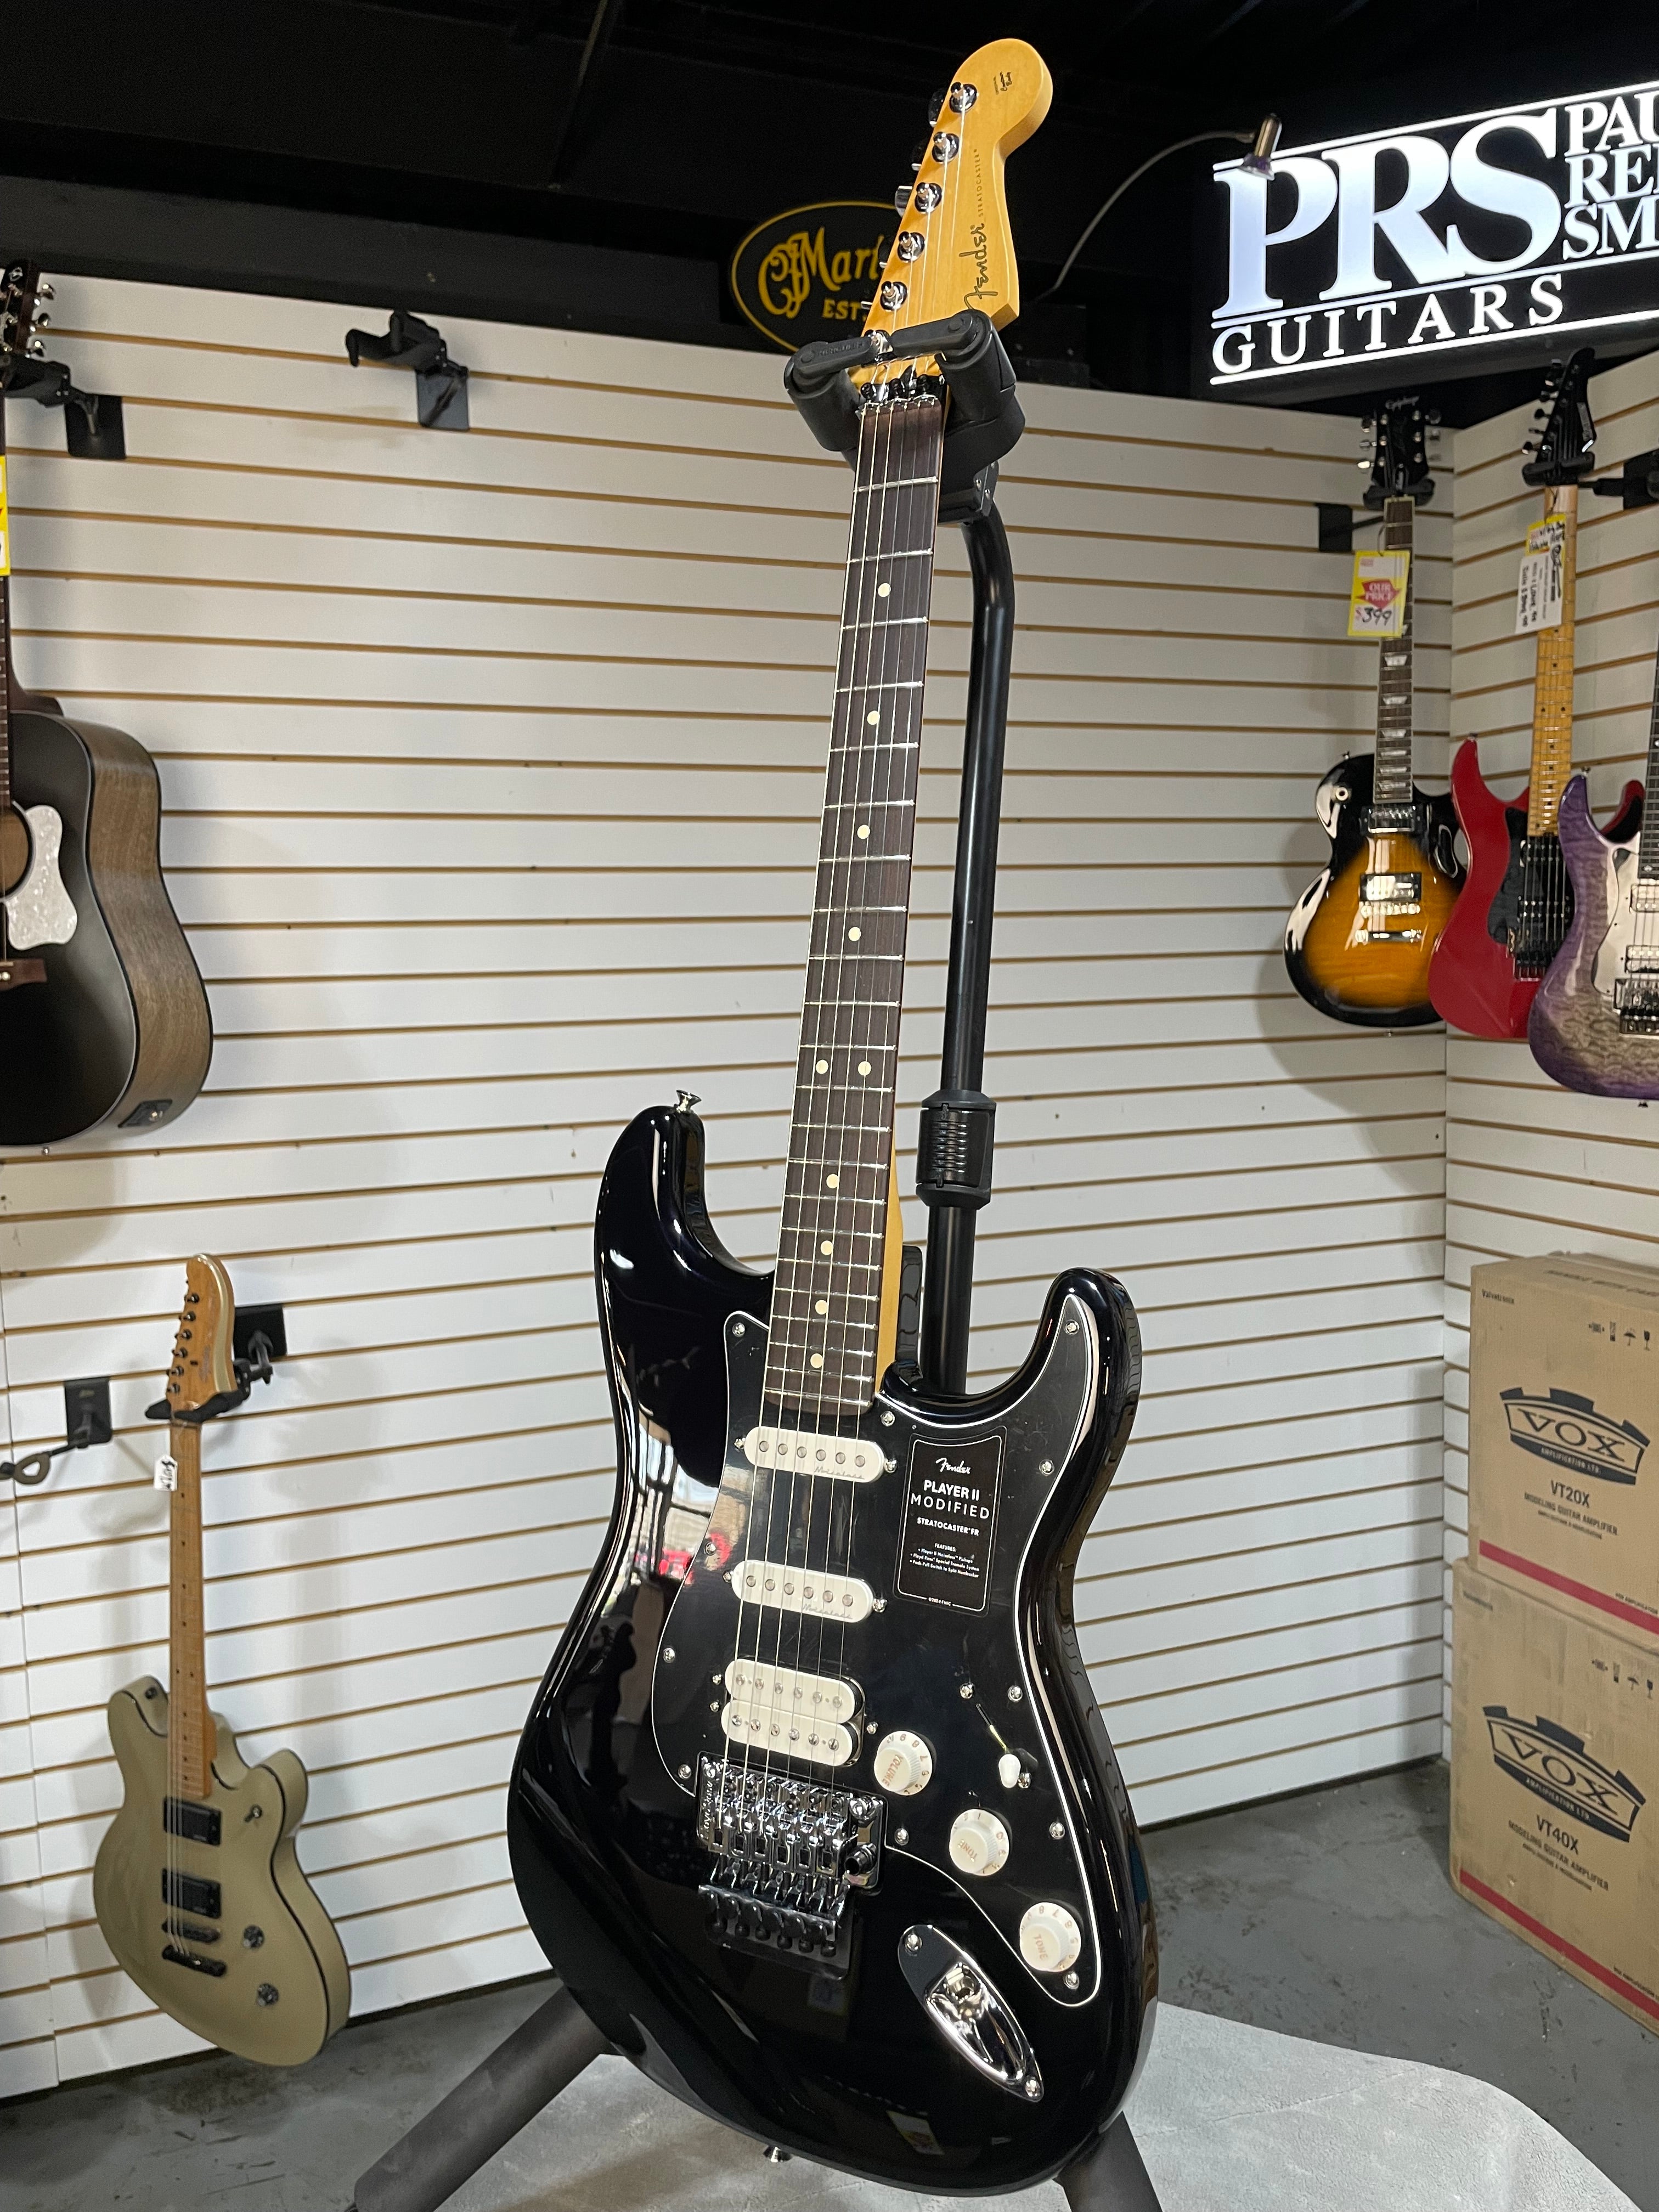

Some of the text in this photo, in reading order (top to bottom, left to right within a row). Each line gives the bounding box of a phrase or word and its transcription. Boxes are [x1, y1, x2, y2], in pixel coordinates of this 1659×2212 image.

[1564, 90, 1659, 157] PAU
[1564, 143, 1659, 209] RE
[1212, 107, 1562, 319] PRS
[1563, 194, 1659, 261] SM
[959, 223, 998, 311] Fender
[1212, 273, 1564, 374] GUITARS
[1518, 1408, 1626, 1463] VOX
[935, 1457, 971, 1474] Fender
[911, 1493, 990, 1519] MODIFIED
[923, 1480, 980, 1501] PLAYER II
[1550, 1480, 1590, 1509] VT20X
[970, 1527, 980, 1536] FR
[882, 1753, 904, 1787] VOLUME
[1502, 1729, 1618, 1815] VOX
[957, 1839, 978, 1863] TONE
[1537, 1813, 1579, 1855] VT40X
[1034, 1933, 1048, 1960] TONE
